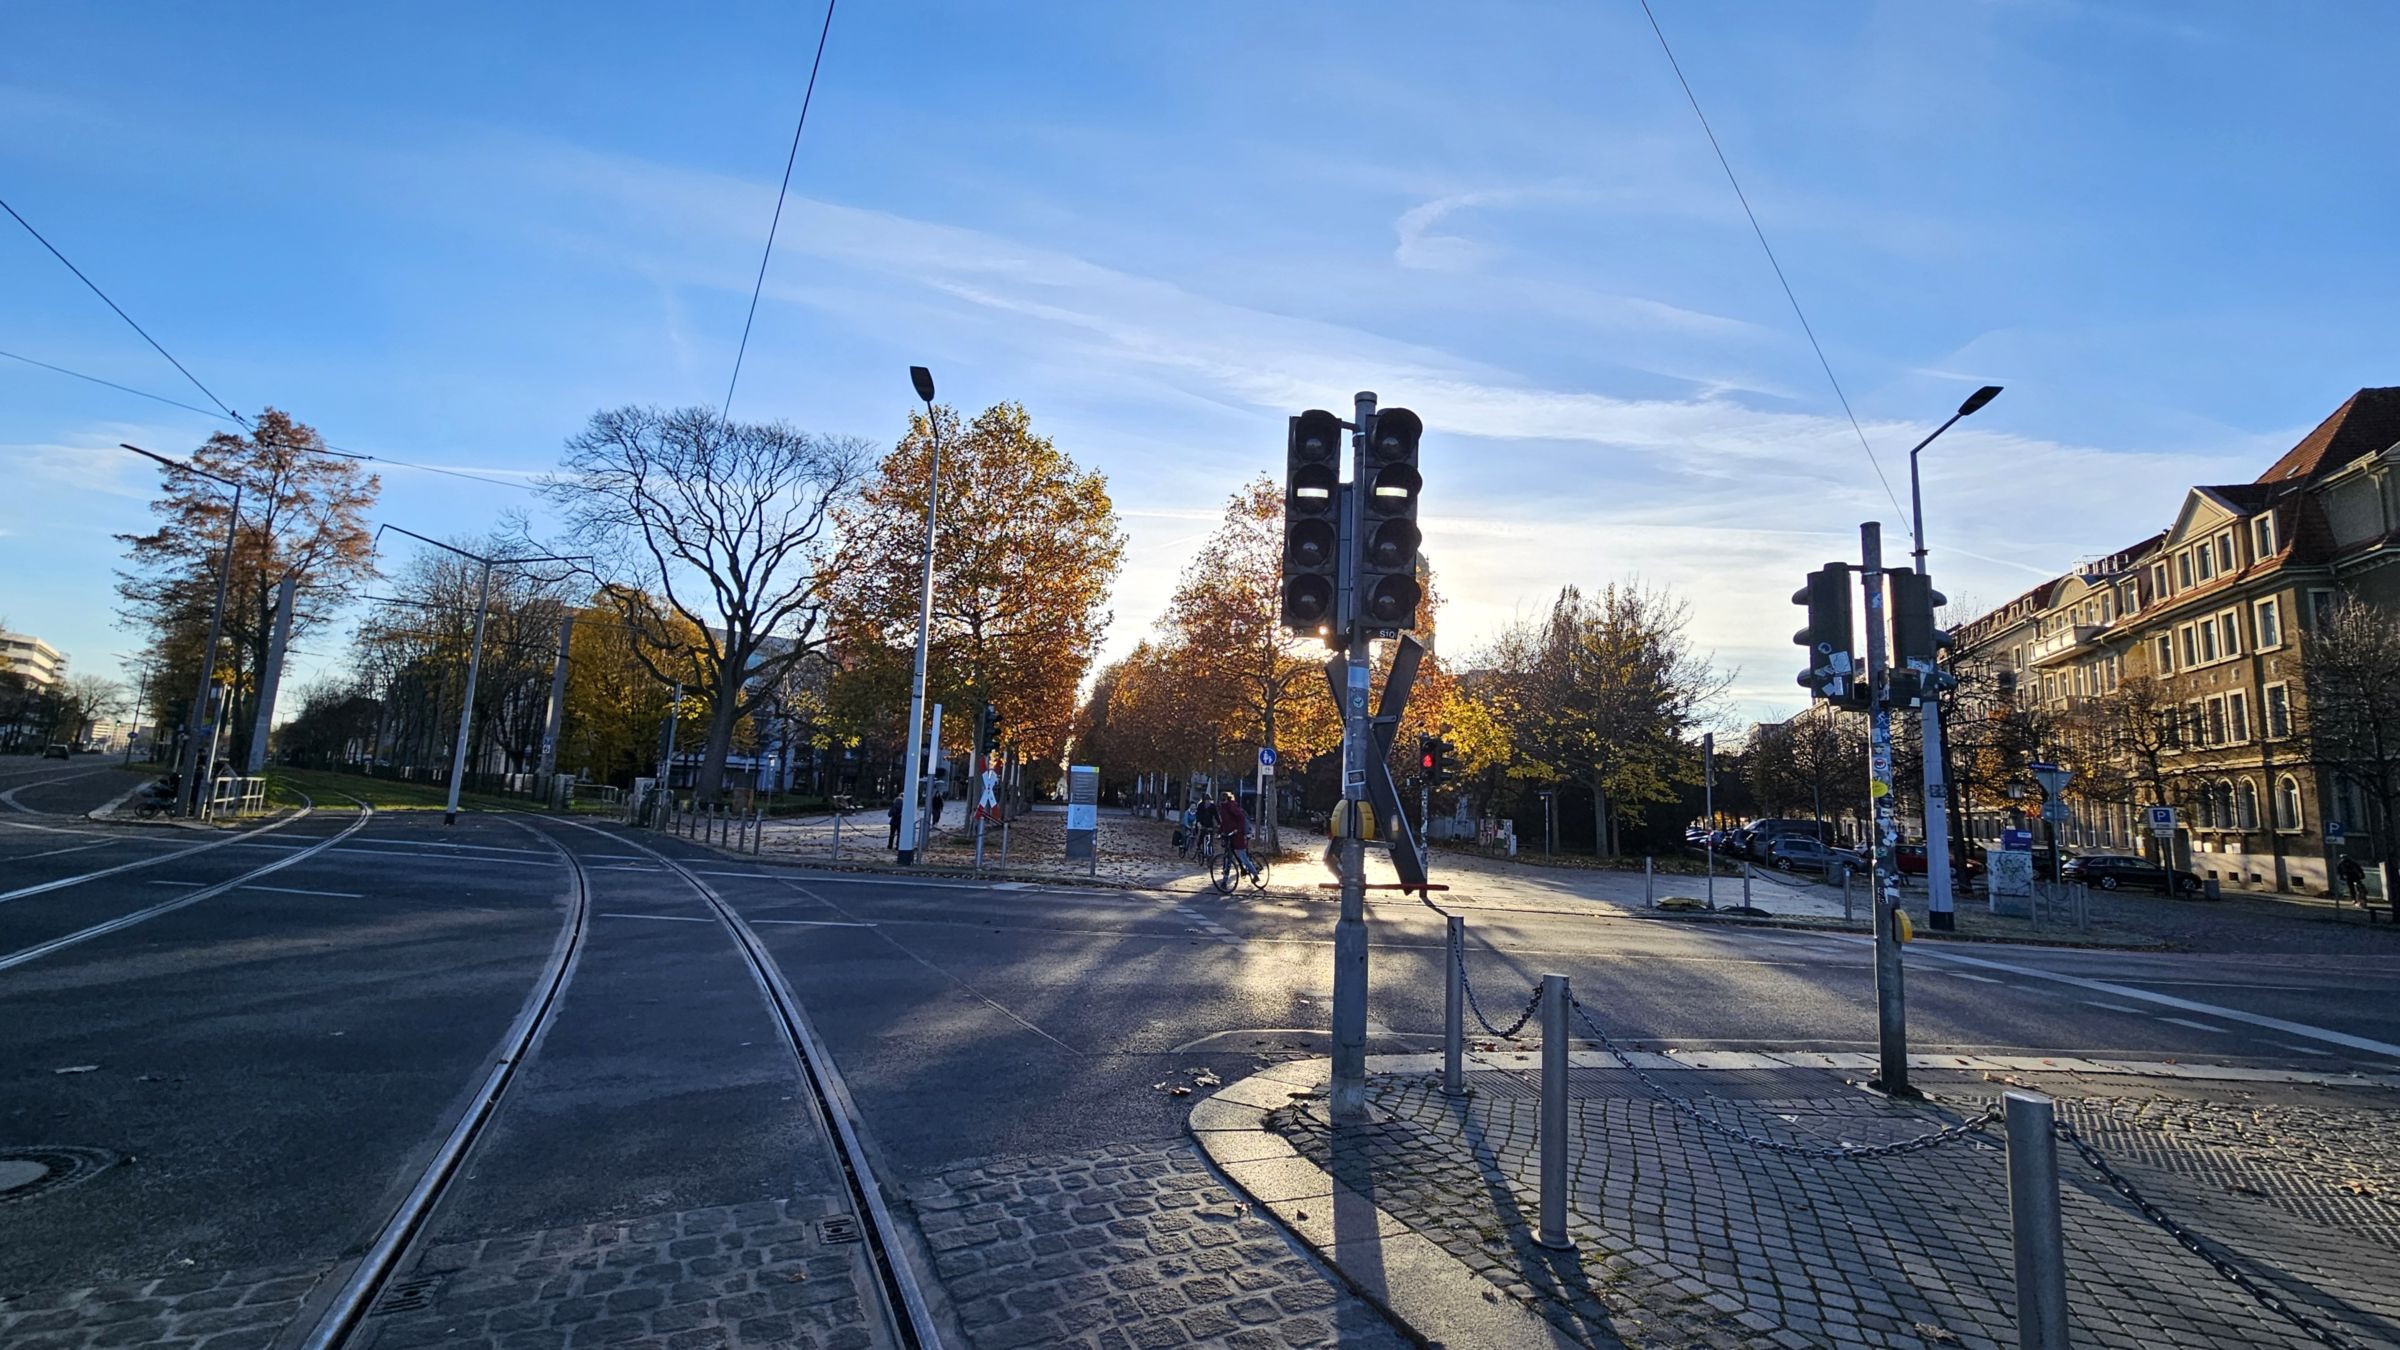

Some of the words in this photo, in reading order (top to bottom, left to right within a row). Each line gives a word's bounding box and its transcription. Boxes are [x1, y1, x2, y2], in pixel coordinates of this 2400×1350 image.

[1379, 630, 1394, 639] S10
[2156, 811, 2166, 821] P
[2329, 822, 2340, 834] P
